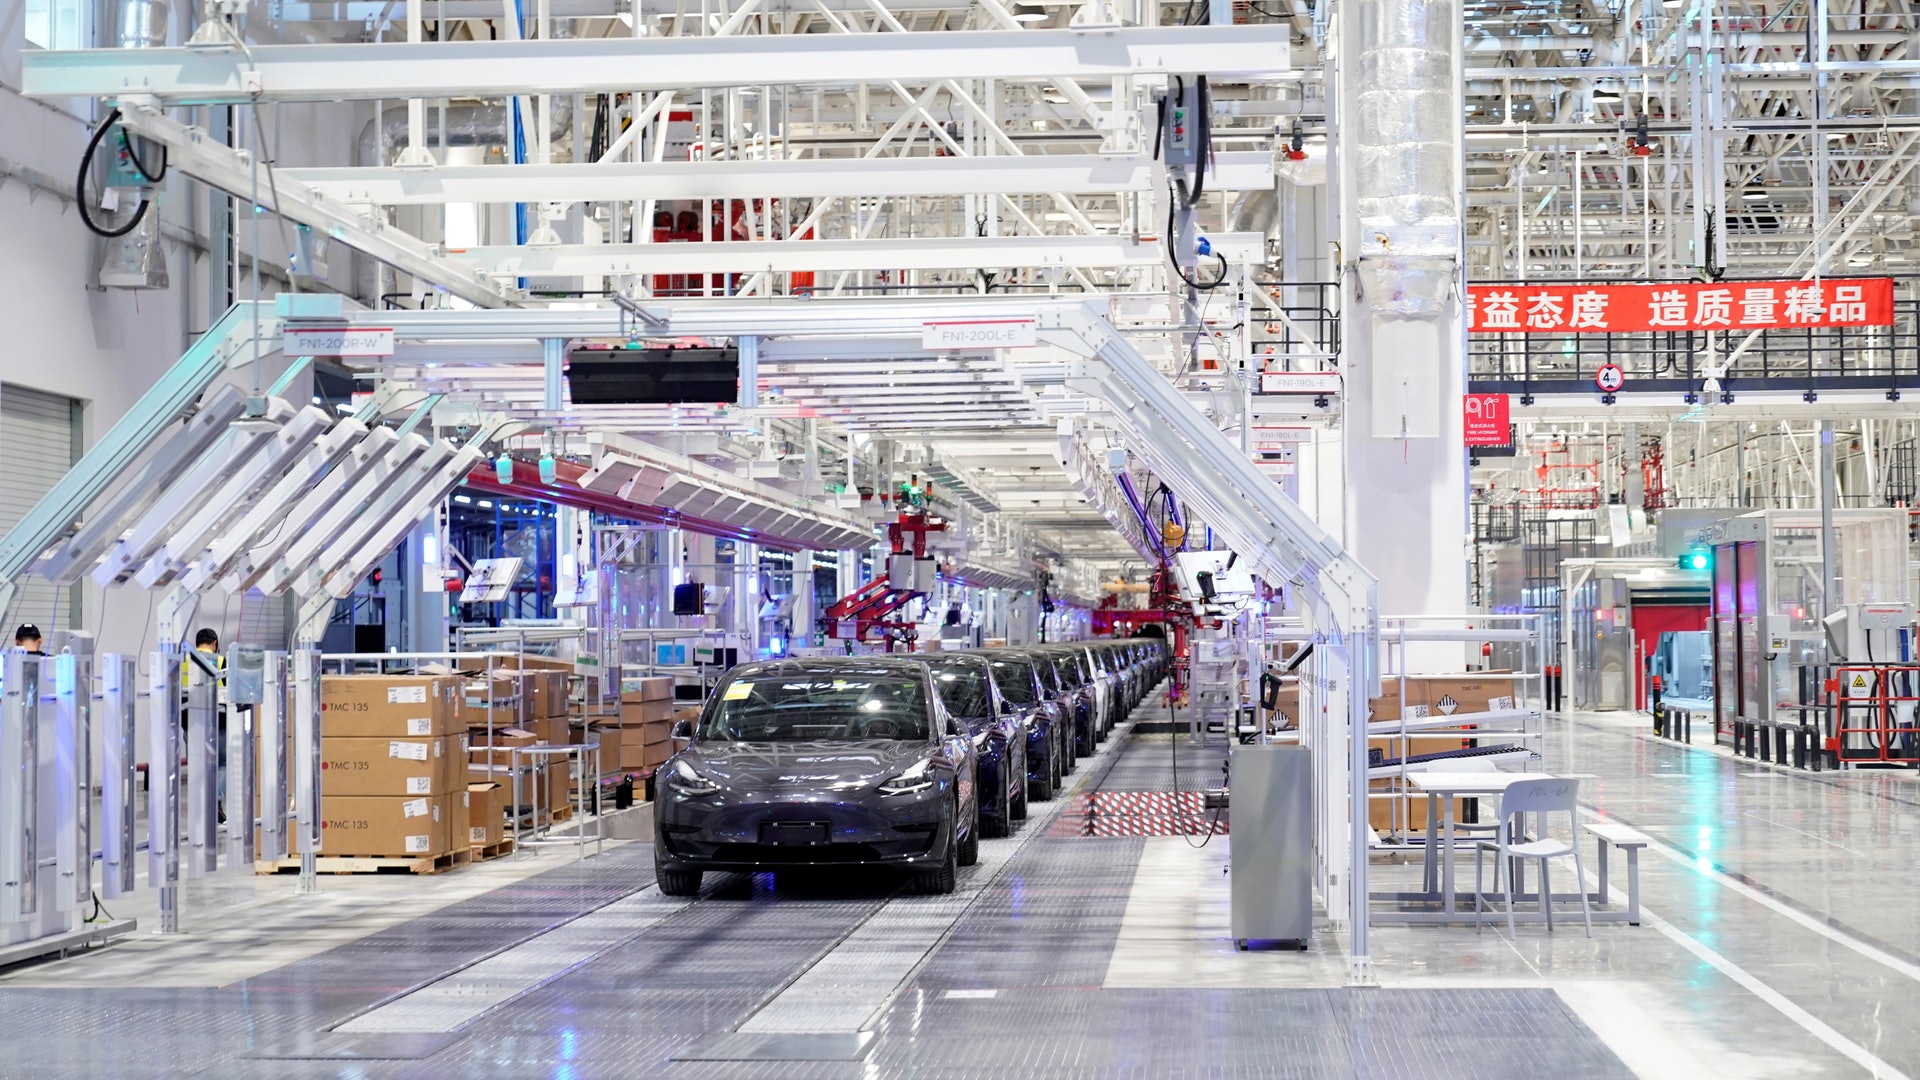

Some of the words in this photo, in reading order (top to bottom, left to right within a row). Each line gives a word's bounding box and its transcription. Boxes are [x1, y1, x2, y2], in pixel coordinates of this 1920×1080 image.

[1647, 285, 1867, 327] 造质量精品
[942, 329, 1016, 342] FN1-200L-E
[299, 338, 377, 349] FN1-200R-W
[1602, 371, 1617, 383] 4m
[1277, 379, 1325, 387] FN1-190L-E
[329, 702, 349, 712] TMC
[352, 702, 369, 712] 135
[330, 761, 350, 770] TMC
[353, 761, 369, 770] 135
[329, 820, 349, 829] TMC
[352, 820, 369, 829] 135
